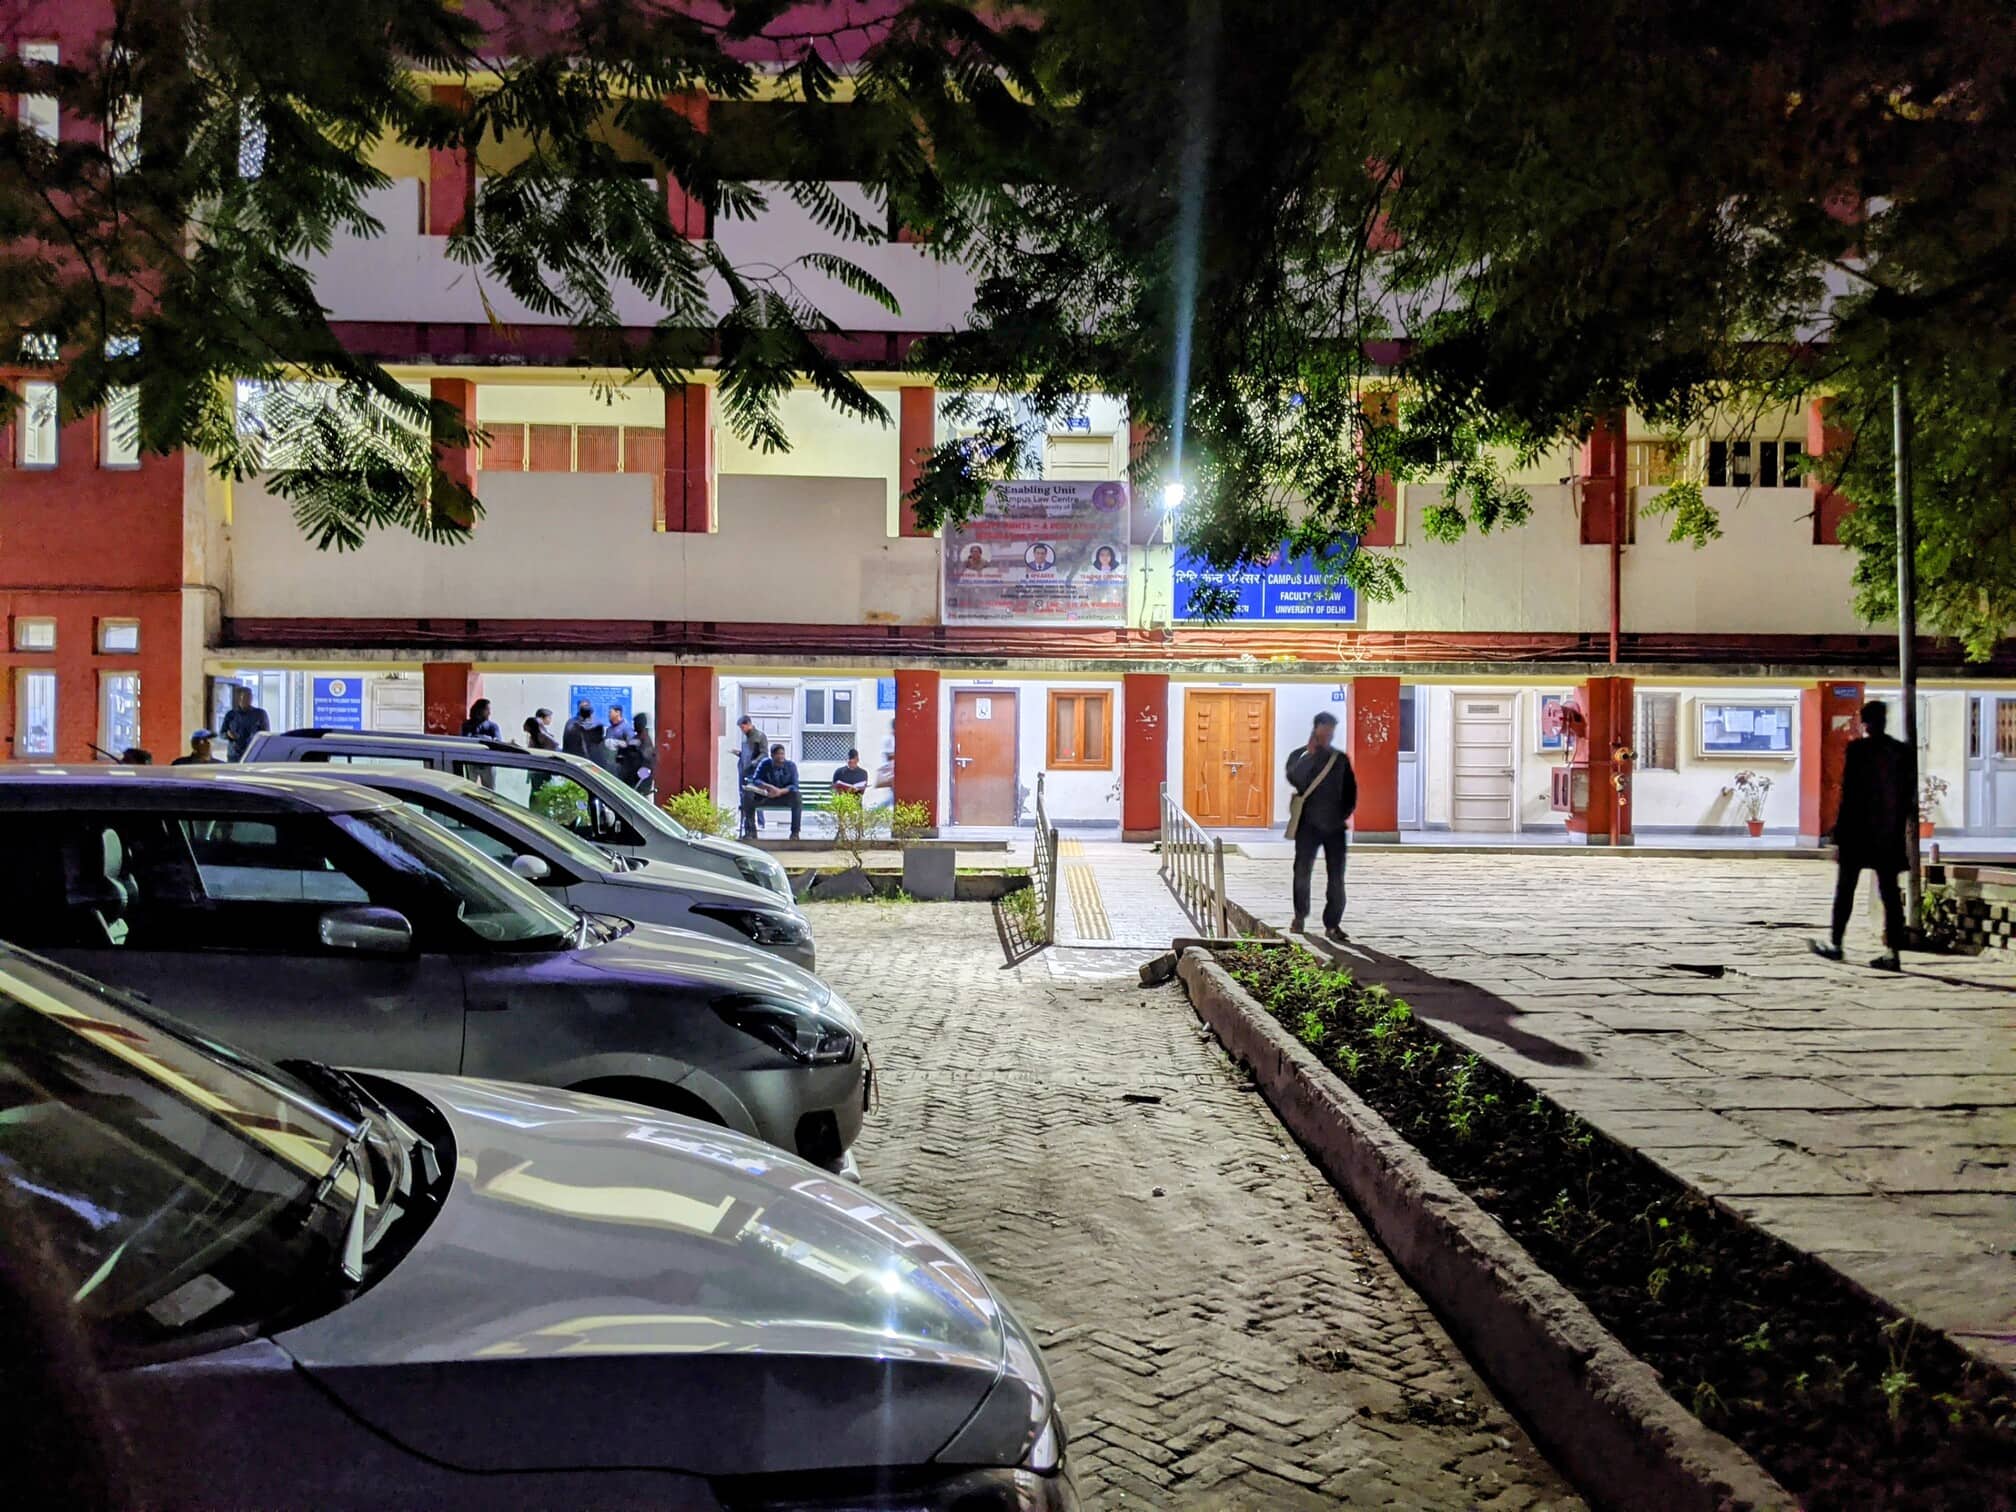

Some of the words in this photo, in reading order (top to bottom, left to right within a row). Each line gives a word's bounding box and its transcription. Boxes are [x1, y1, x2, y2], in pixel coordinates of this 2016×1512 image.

[1005, 485, 1050, 496] Enabling
[1053, 486, 1076, 494] Unit
[1268, 574, 1302, 585] CAMPUS
[1304, 574, 1322, 585] LAW
[1280, 591, 1311, 601] FACULTY
[1275, 605, 1315, 614] UNIVERSITY
[1316, 605, 1325, 614] OF
[1326, 605, 1347, 614] DELHI
